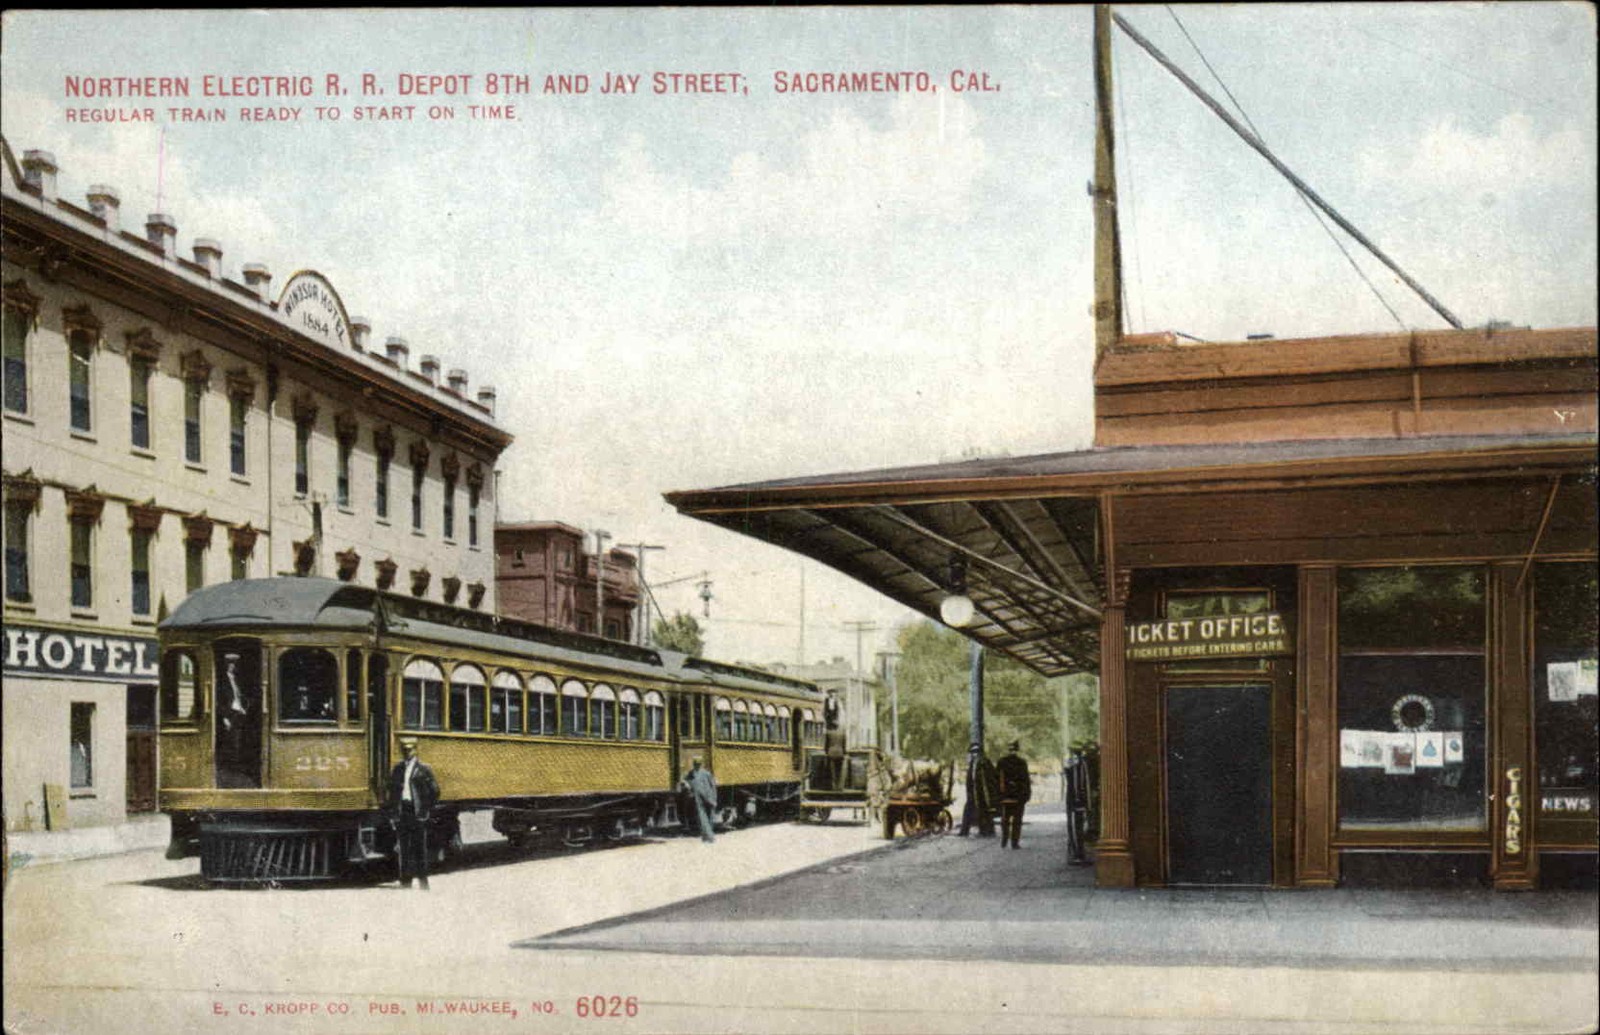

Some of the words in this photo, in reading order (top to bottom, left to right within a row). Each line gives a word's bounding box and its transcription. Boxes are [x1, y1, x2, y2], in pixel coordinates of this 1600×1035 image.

[1124, 621, 1194, 643] ICKET
[6, 627, 159, 675] HOTEL
[1506, 767, 1521, 854] CIGARS
[1541, 797, 1591, 811] NEWS
